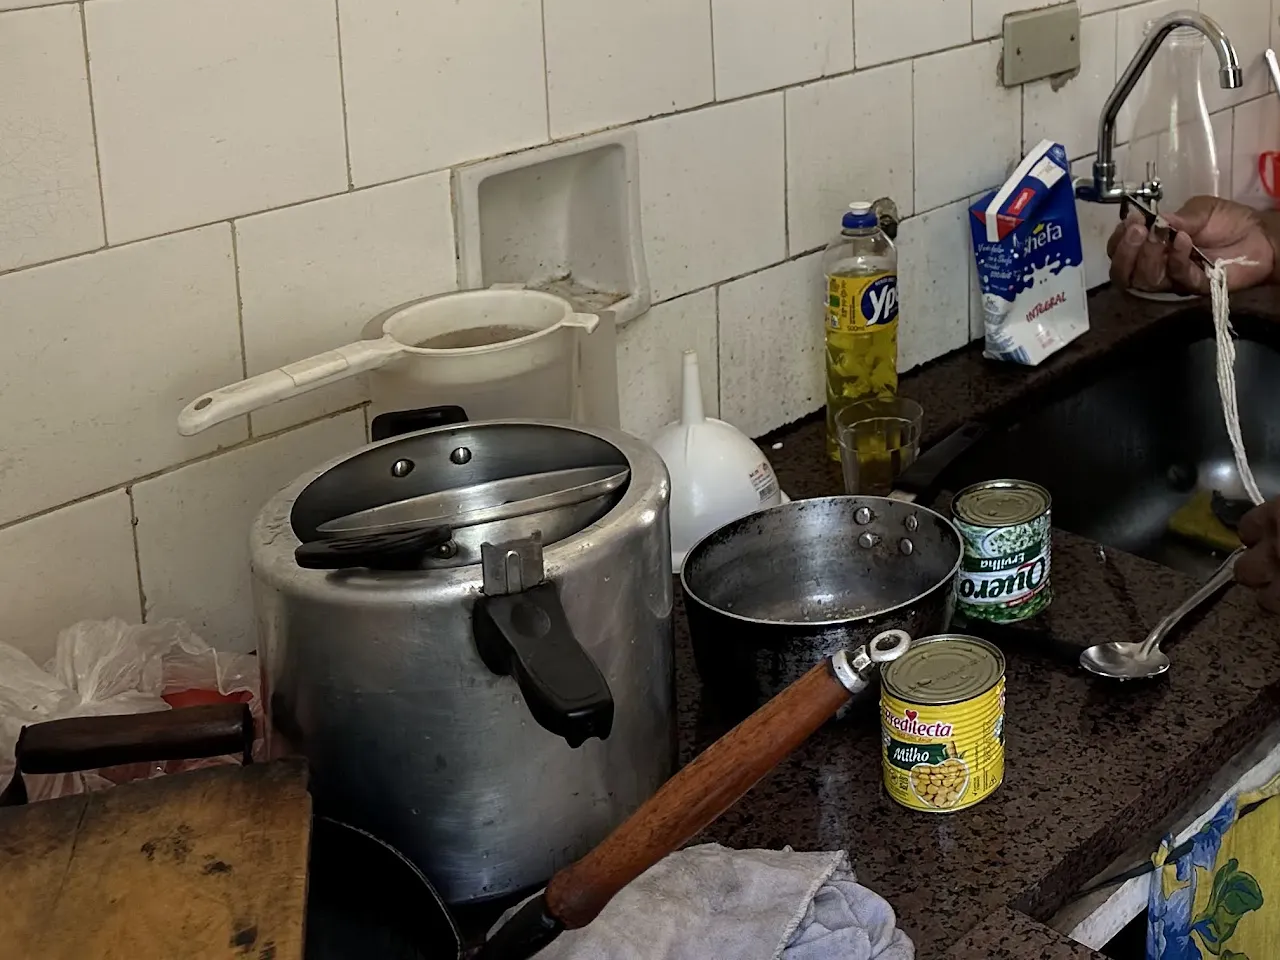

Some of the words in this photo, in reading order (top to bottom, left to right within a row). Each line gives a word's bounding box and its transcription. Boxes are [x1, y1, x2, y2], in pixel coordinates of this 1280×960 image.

[864, 284, 898, 328] Yp
[1025, 291, 1067, 323] INTEGRAL
[958, 556, 1047, 599] Quero
[979, 552, 1026, 571] Ervilha
[883, 706, 953, 738] Predilecta
[892, 746, 931, 763] Milho
